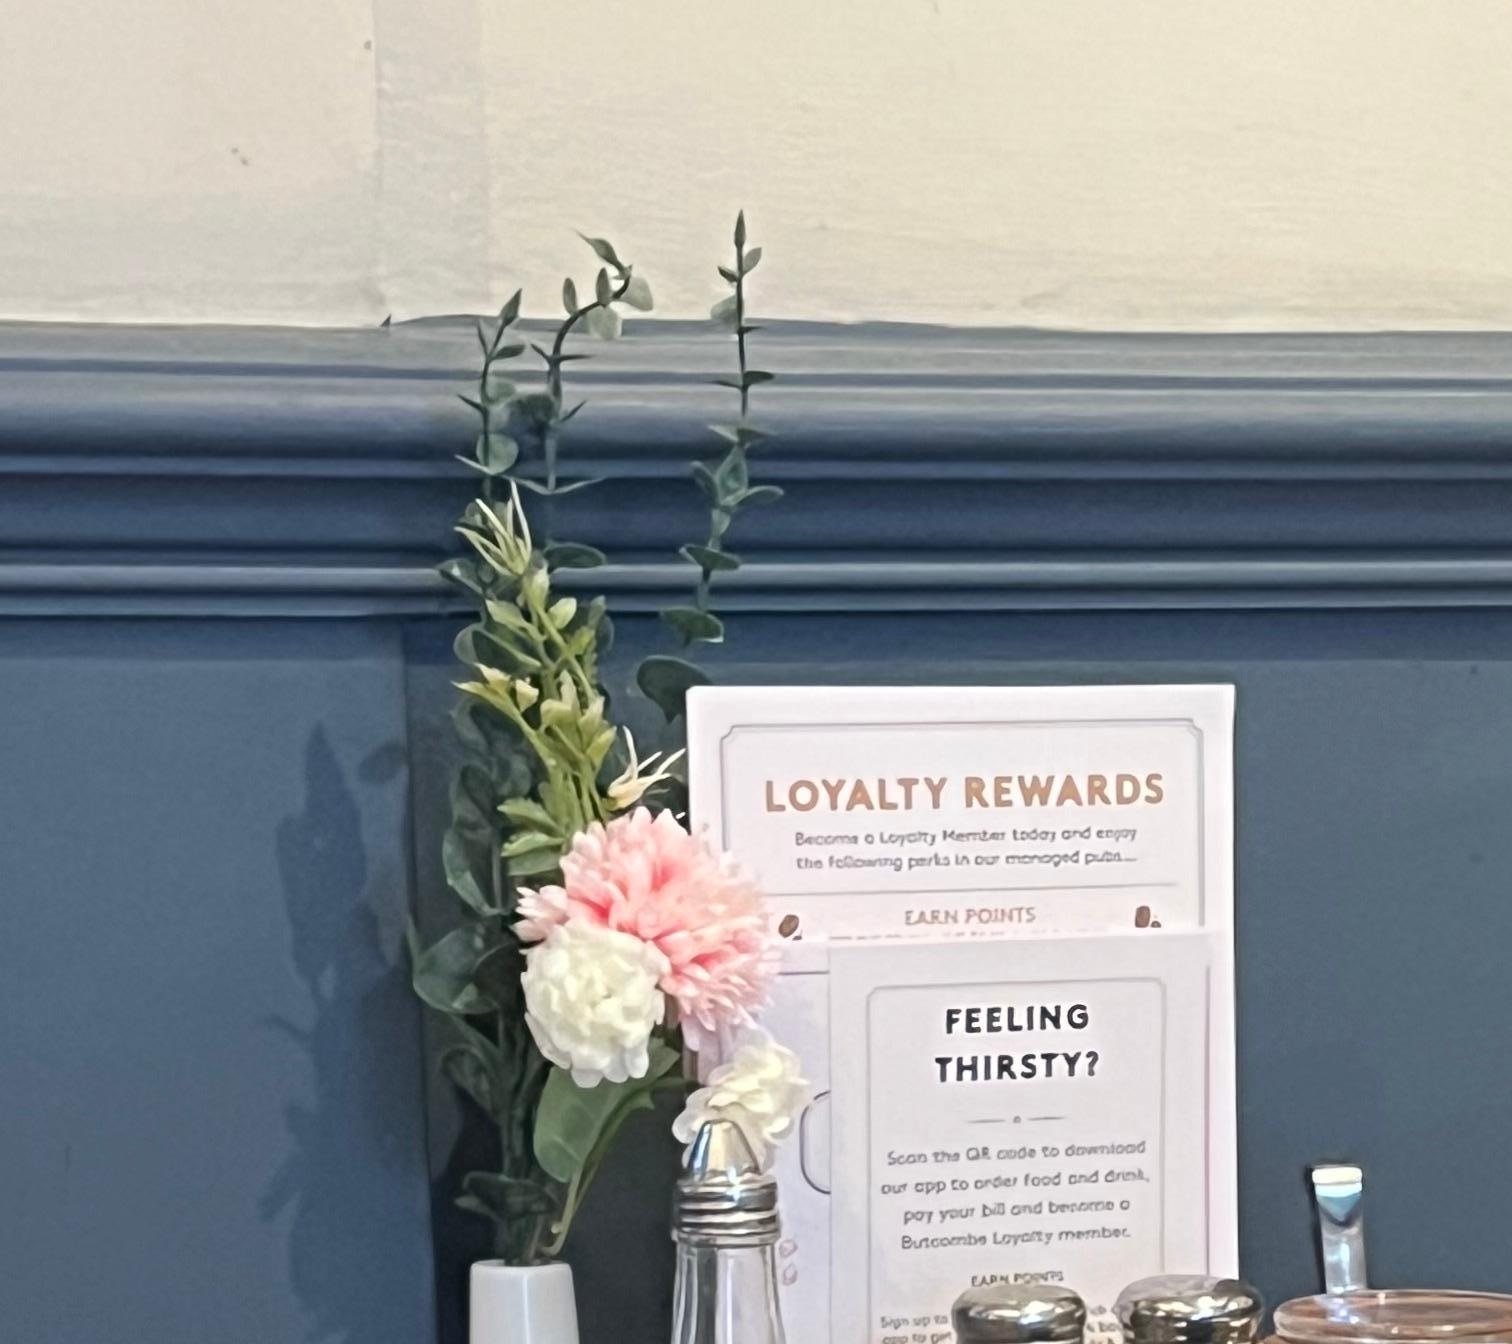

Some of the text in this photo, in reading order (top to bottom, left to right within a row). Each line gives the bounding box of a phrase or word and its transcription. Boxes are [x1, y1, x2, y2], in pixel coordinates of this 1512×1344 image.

[764, 772, 1165, 813] LOYALTY REWARDS
[795, 831, 858, 846] Become
[880, 830, 936, 847] Loyalty
[942, 829, 1006, 842] Member
[1012, 828, 1056, 842] today
[1061, 827, 1091, 840] and
[1096, 828, 1137, 842] enjoy
[797, 857, 823, 869] the
[829, 854, 903, 871] following
[908, 852, 950, 870] perks
[955, 853, 970, 866] in
[975, 856, 999, 865] our
[1005, 851, 1080, 867] managed
[904, 906, 1036, 925] EARN POINTS
[945, 1004, 1090, 1034] FEELING
[934, 1051, 1099, 1083] THIRSTY?
[887, 1140, 1146, 1166] Scan the QR code to download
[881, 1168, 1150, 1195] our app to order food and drink,
[903, 1200, 1130, 1225] pay your bill and become a
[901, 1226, 1131, 1249] Butcombe Loyalty member.
[971, 1271, 1064, 1287] EARN POINTS
[880, 1315, 909, 1330] Sign
[913, 1317, 931, 1328] up
